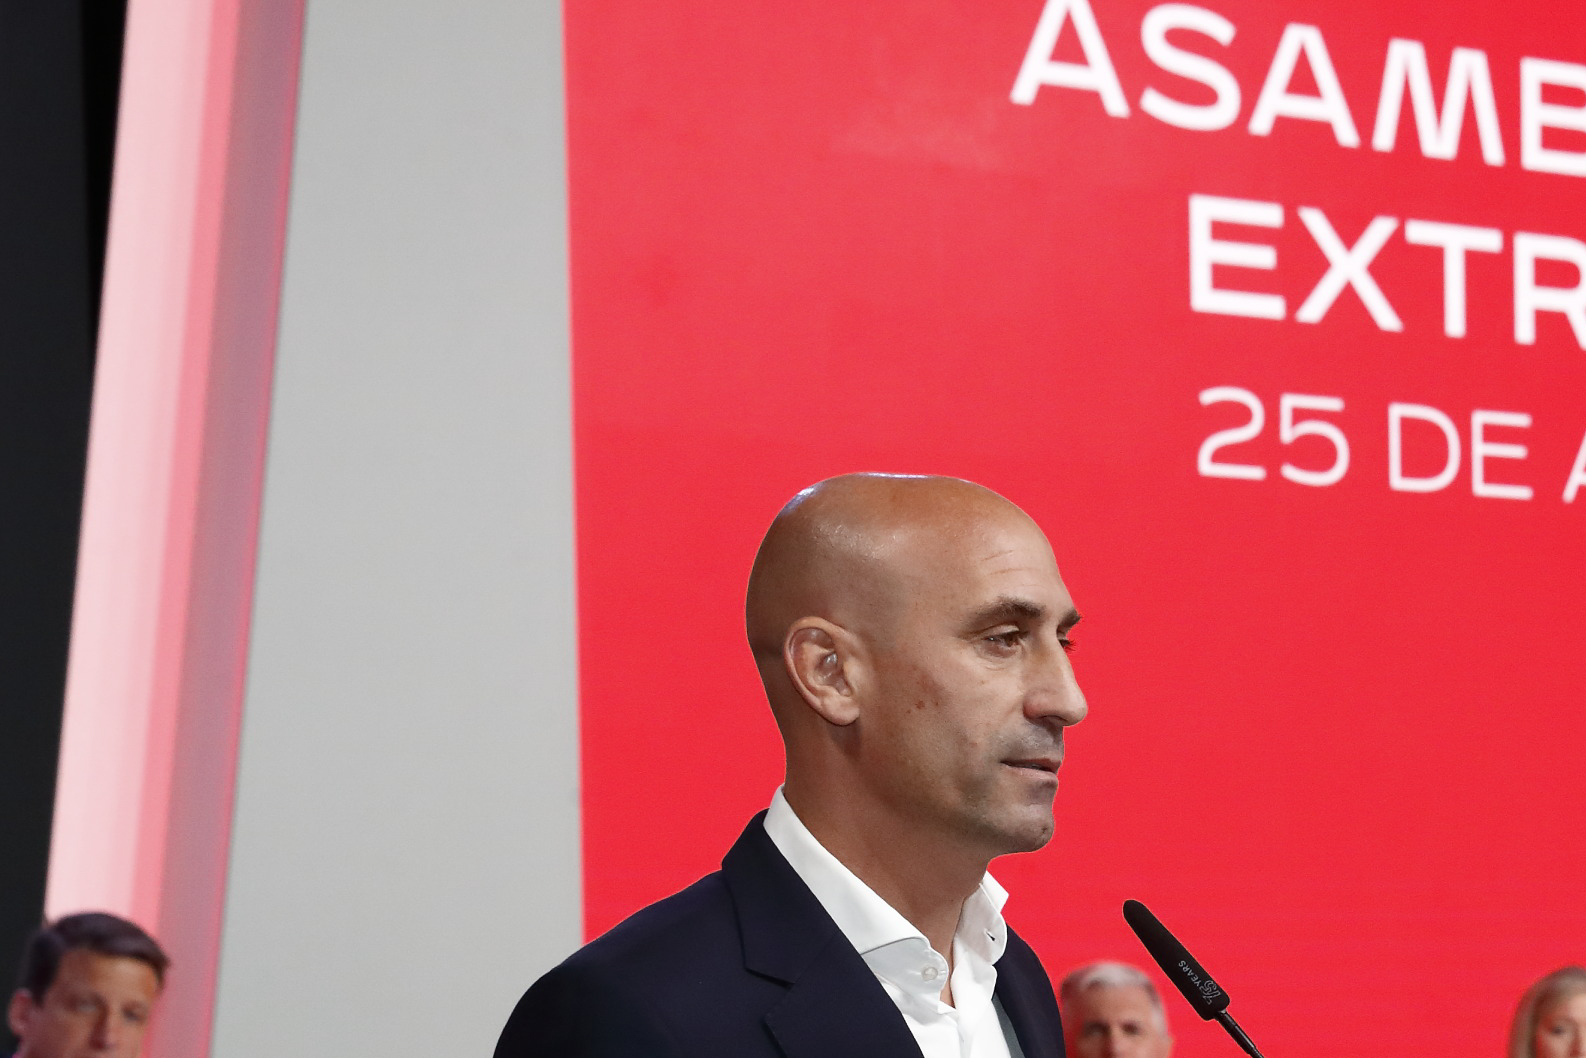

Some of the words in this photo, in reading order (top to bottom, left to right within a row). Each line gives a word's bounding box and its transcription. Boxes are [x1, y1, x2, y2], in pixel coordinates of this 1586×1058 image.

[1197, 386, 1350, 487] 25
[1387, 402, 1533, 501] DE
[1178, 960, 1202, 987] YEARS
